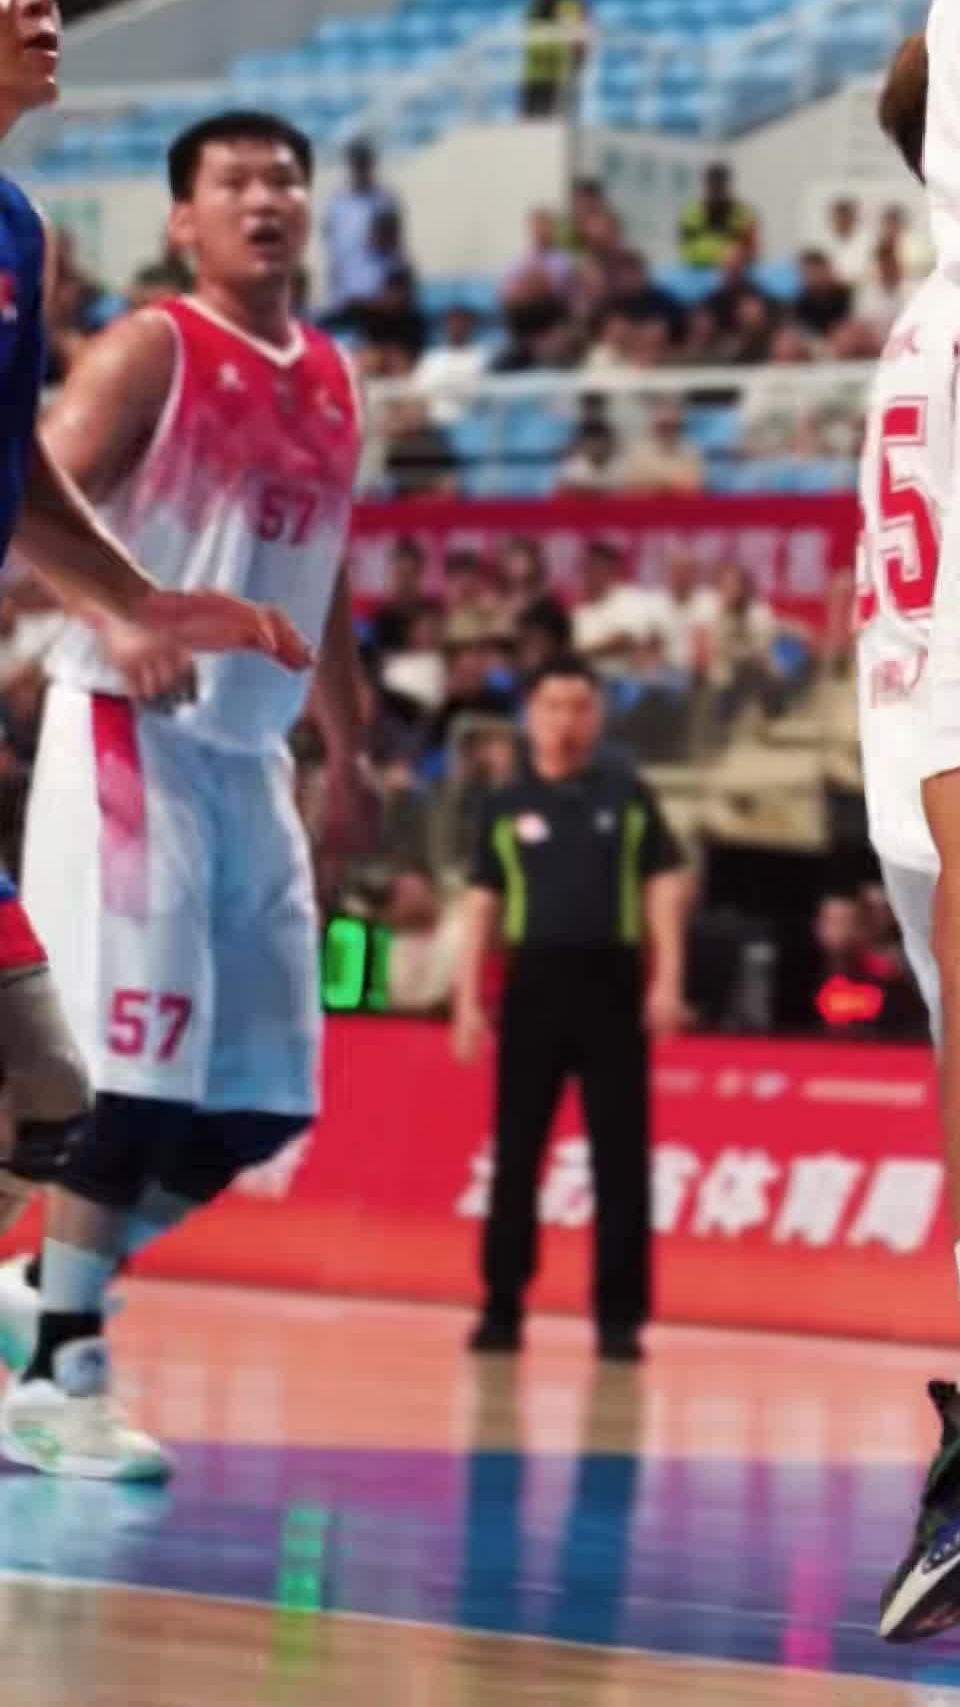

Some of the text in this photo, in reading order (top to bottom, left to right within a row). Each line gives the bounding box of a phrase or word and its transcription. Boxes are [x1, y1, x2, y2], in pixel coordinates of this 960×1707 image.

[257, 485, 319, 548] 57
[854, 396, 943, 630] 5
[107, 987, 193, 1063] 57
